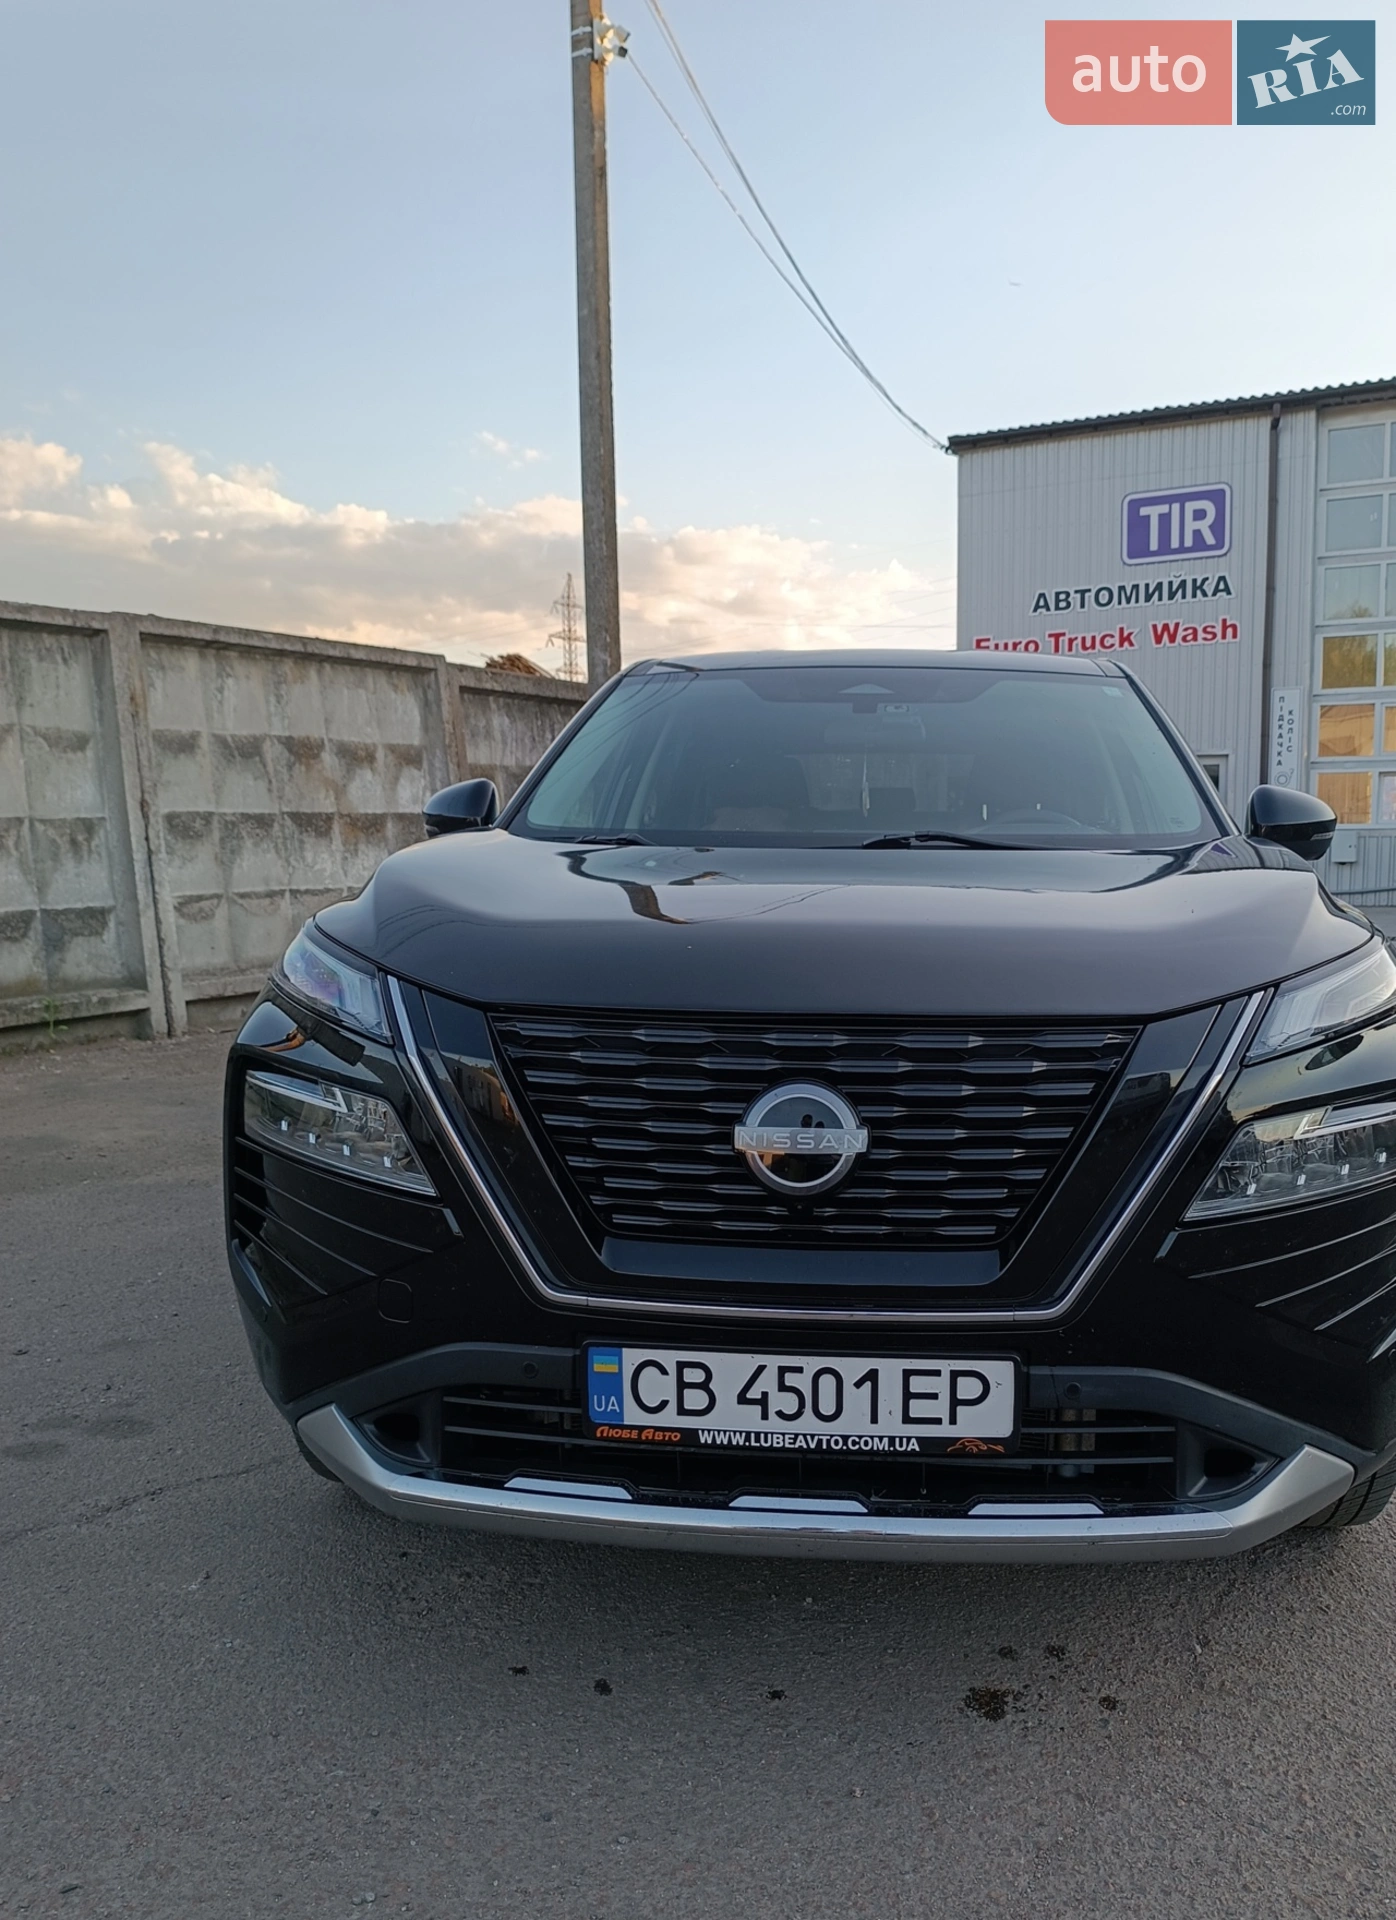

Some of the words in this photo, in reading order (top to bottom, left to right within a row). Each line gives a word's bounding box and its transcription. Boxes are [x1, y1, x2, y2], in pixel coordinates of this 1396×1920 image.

[1139, 499, 1217, 551] TIR
[1032, 573, 1233, 614] АВТОМИЙКА
[1047, 626, 1136, 655] Truck
[1151, 617, 1239, 646] Wash
[1276, 696, 1285, 767] ПІДКАЧКА
[1286, 709, 1295, 753] КОЛІС
[738, 1130, 863, 1150] NISSAN
[593, 1394, 621, 1414] UA
[630, 1358, 717, 1418] CB
[736, 1363, 880, 1425] 4501
[901, 1367, 992, 1426] EP
[698, 1430, 920, 1453] WWW.LUBEAVTO.COM.UA
